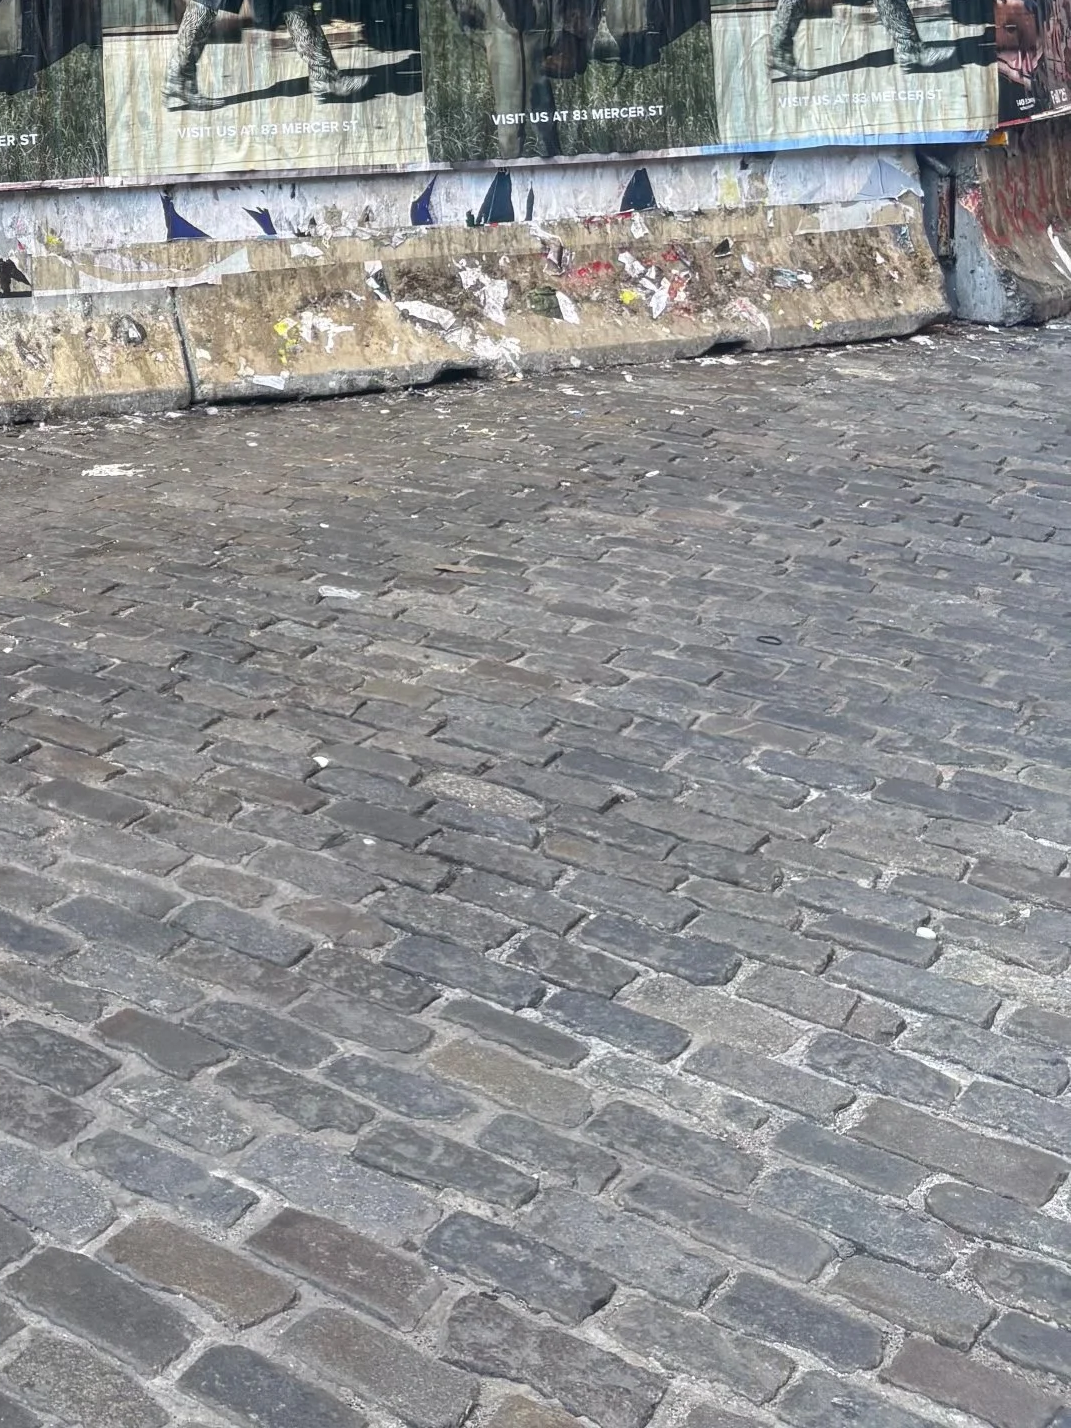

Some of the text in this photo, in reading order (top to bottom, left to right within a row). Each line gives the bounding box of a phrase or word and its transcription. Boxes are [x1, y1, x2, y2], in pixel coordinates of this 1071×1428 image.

[778, 96, 810, 109] VISIT
[813, 95, 830, 107] US
[834, 94, 850, 105] AT
[852, 93, 867, 105] 83
[927, 89, 944, 101] ST
[491, 105, 664, 126] VISIT US AT 83 MERCER ST
[20, 133, 39, 146] ST
[178, 120, 359, 140] VISIT US AT 83 MERCER ST
